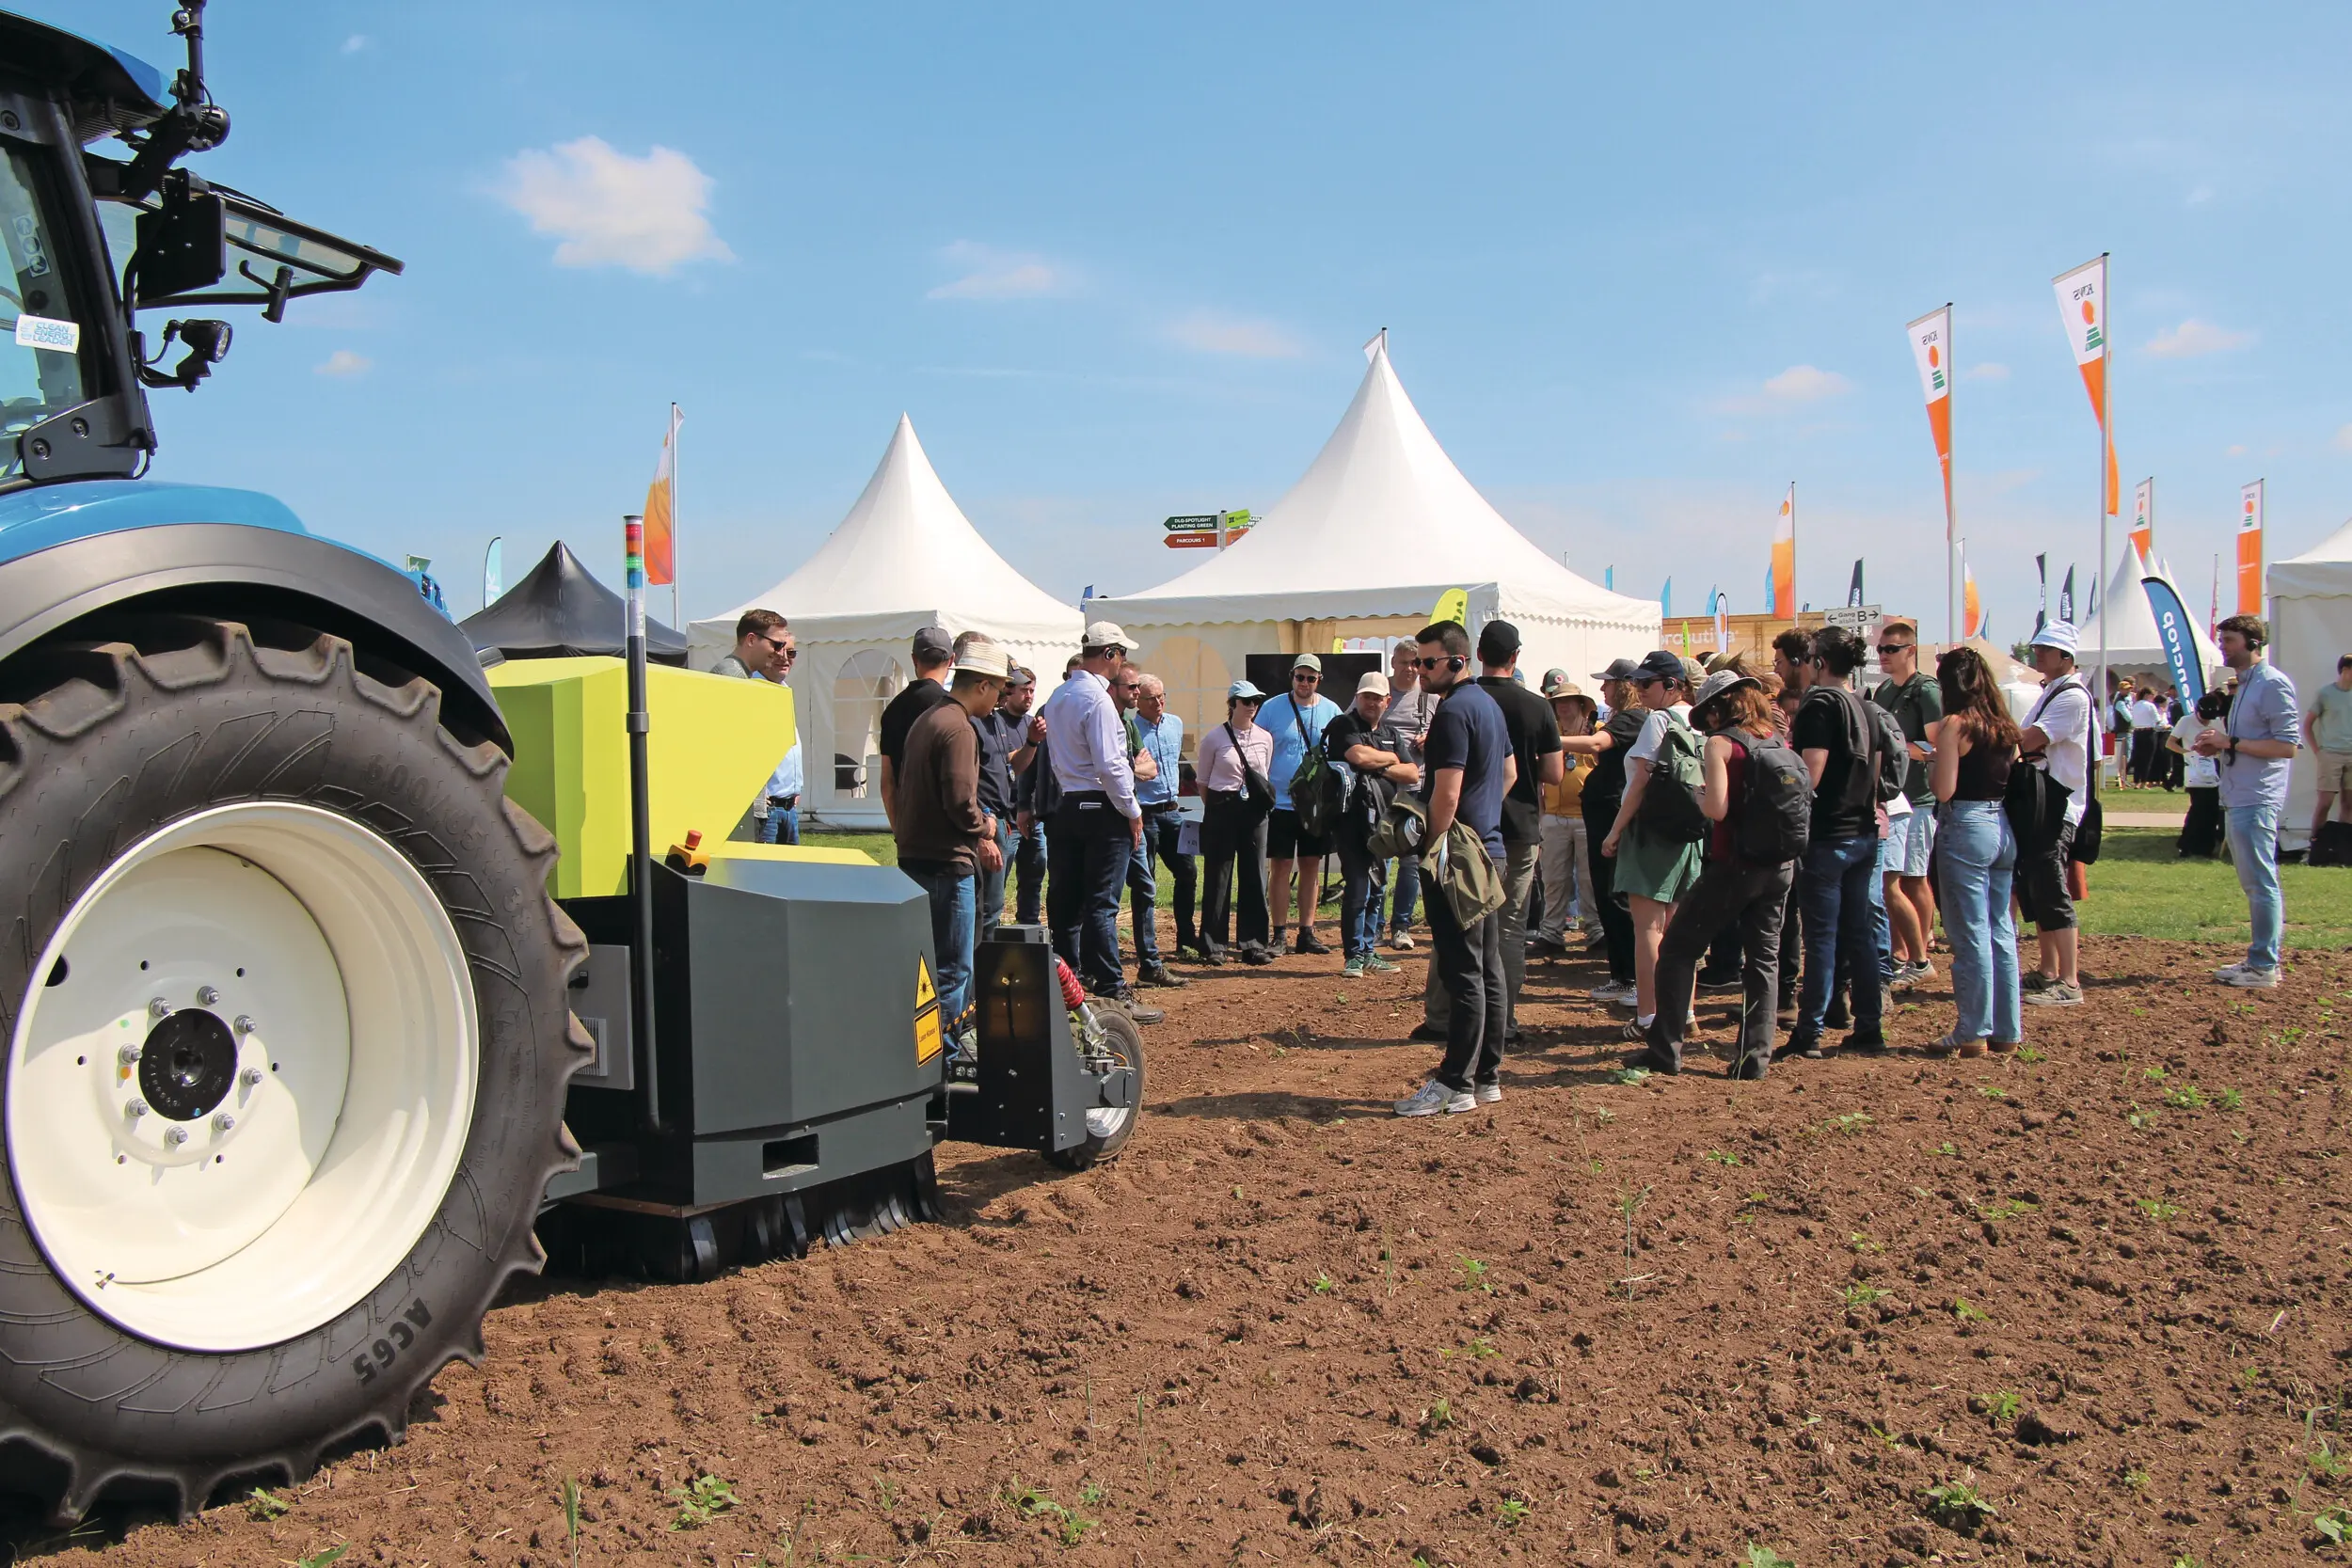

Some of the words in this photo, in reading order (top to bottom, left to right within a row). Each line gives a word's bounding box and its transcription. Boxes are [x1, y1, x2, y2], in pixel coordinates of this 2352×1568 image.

[36, 323, 69, 333] CLEAN
[33, 335, 73, 346] LEADER
[35, 328, 75, 341] ENERGY
[1857, 610, 1867, 622] B
[353, 1297, 432, 1386] AC65
